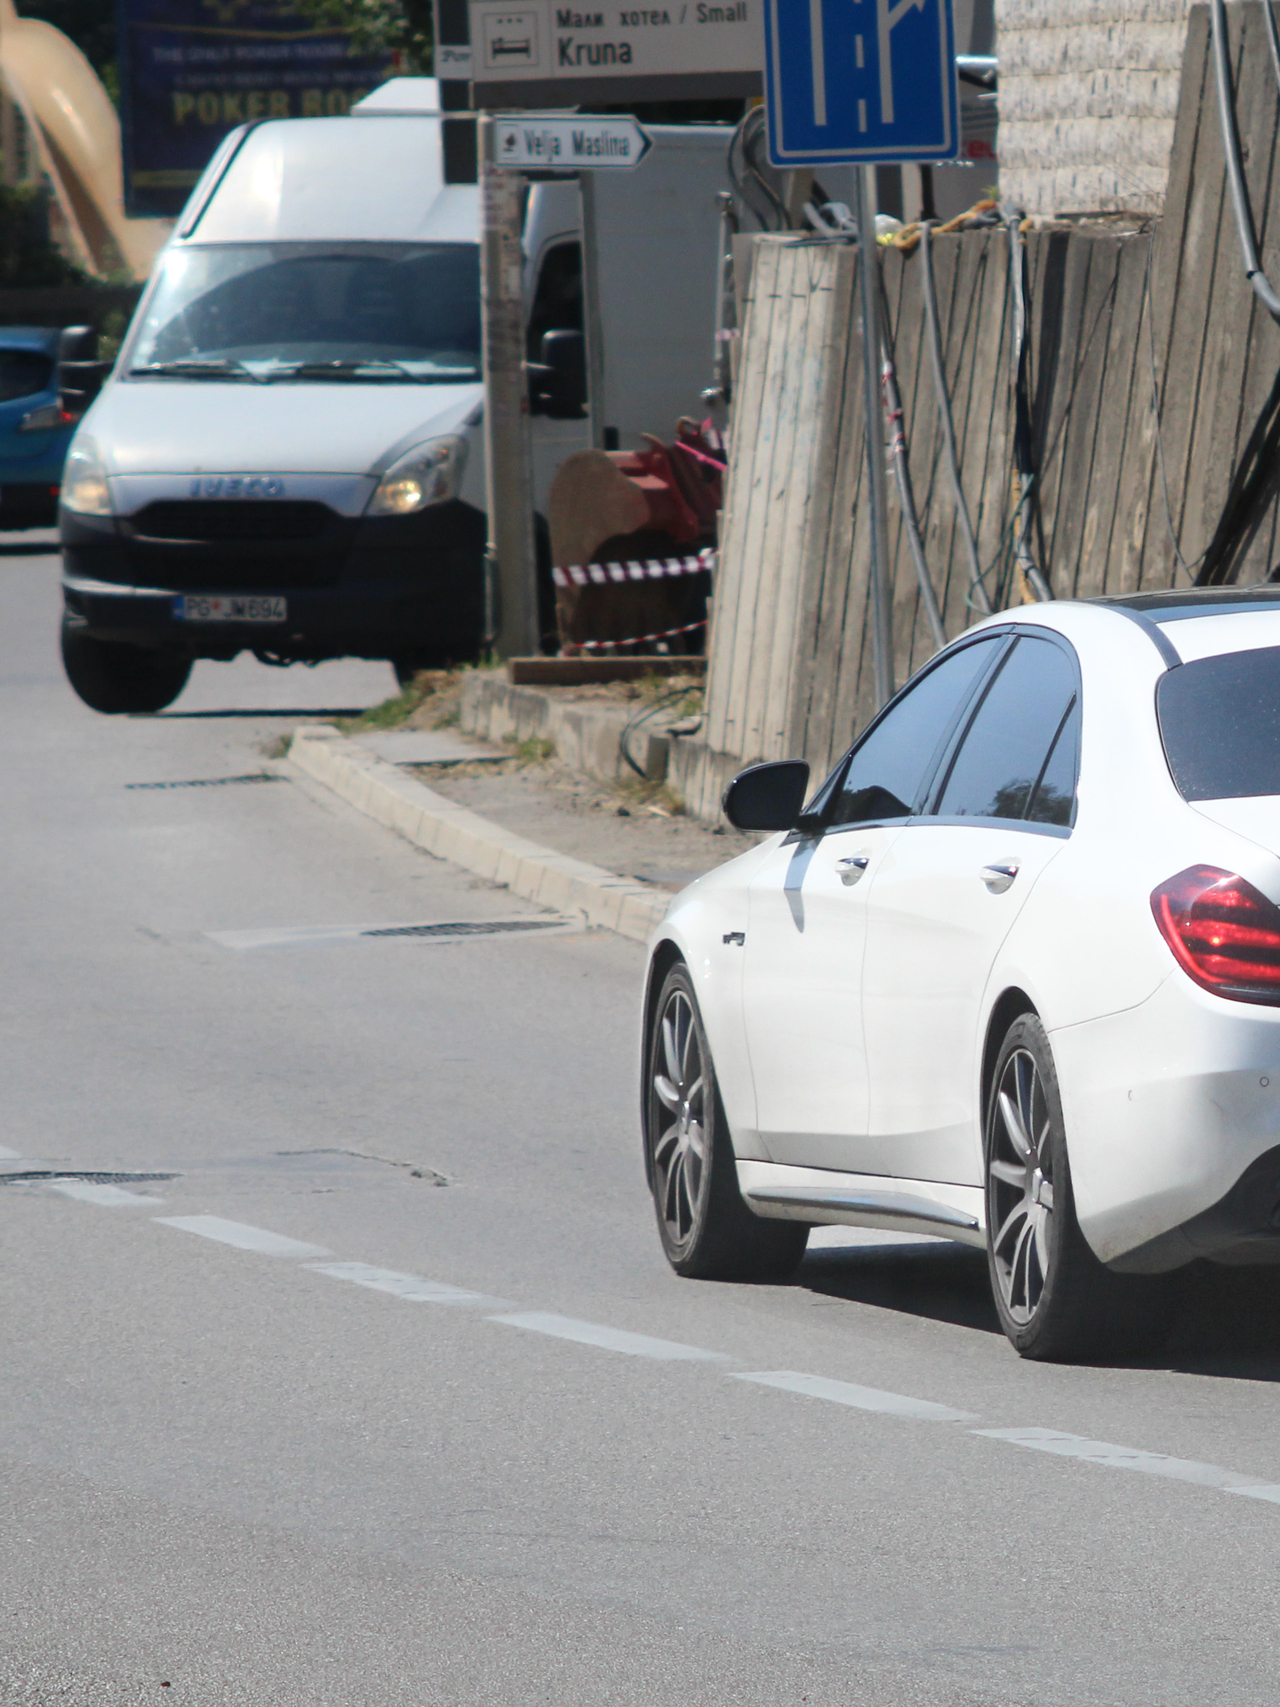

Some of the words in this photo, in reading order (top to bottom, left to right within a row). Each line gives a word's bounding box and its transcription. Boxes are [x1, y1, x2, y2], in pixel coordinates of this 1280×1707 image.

[556, 8, 604, 28] Мали
[620, 10, 670, 26] хотел
[697, 2, 747, 24] Small
[557, 37, 633, 67] Kruna
[172, 89, 290, 125] POKER
[523, 129, 562, 162] Velja
[571, 130, 631, 157] Maslina
[190, 477, 286, 498] IVECO
